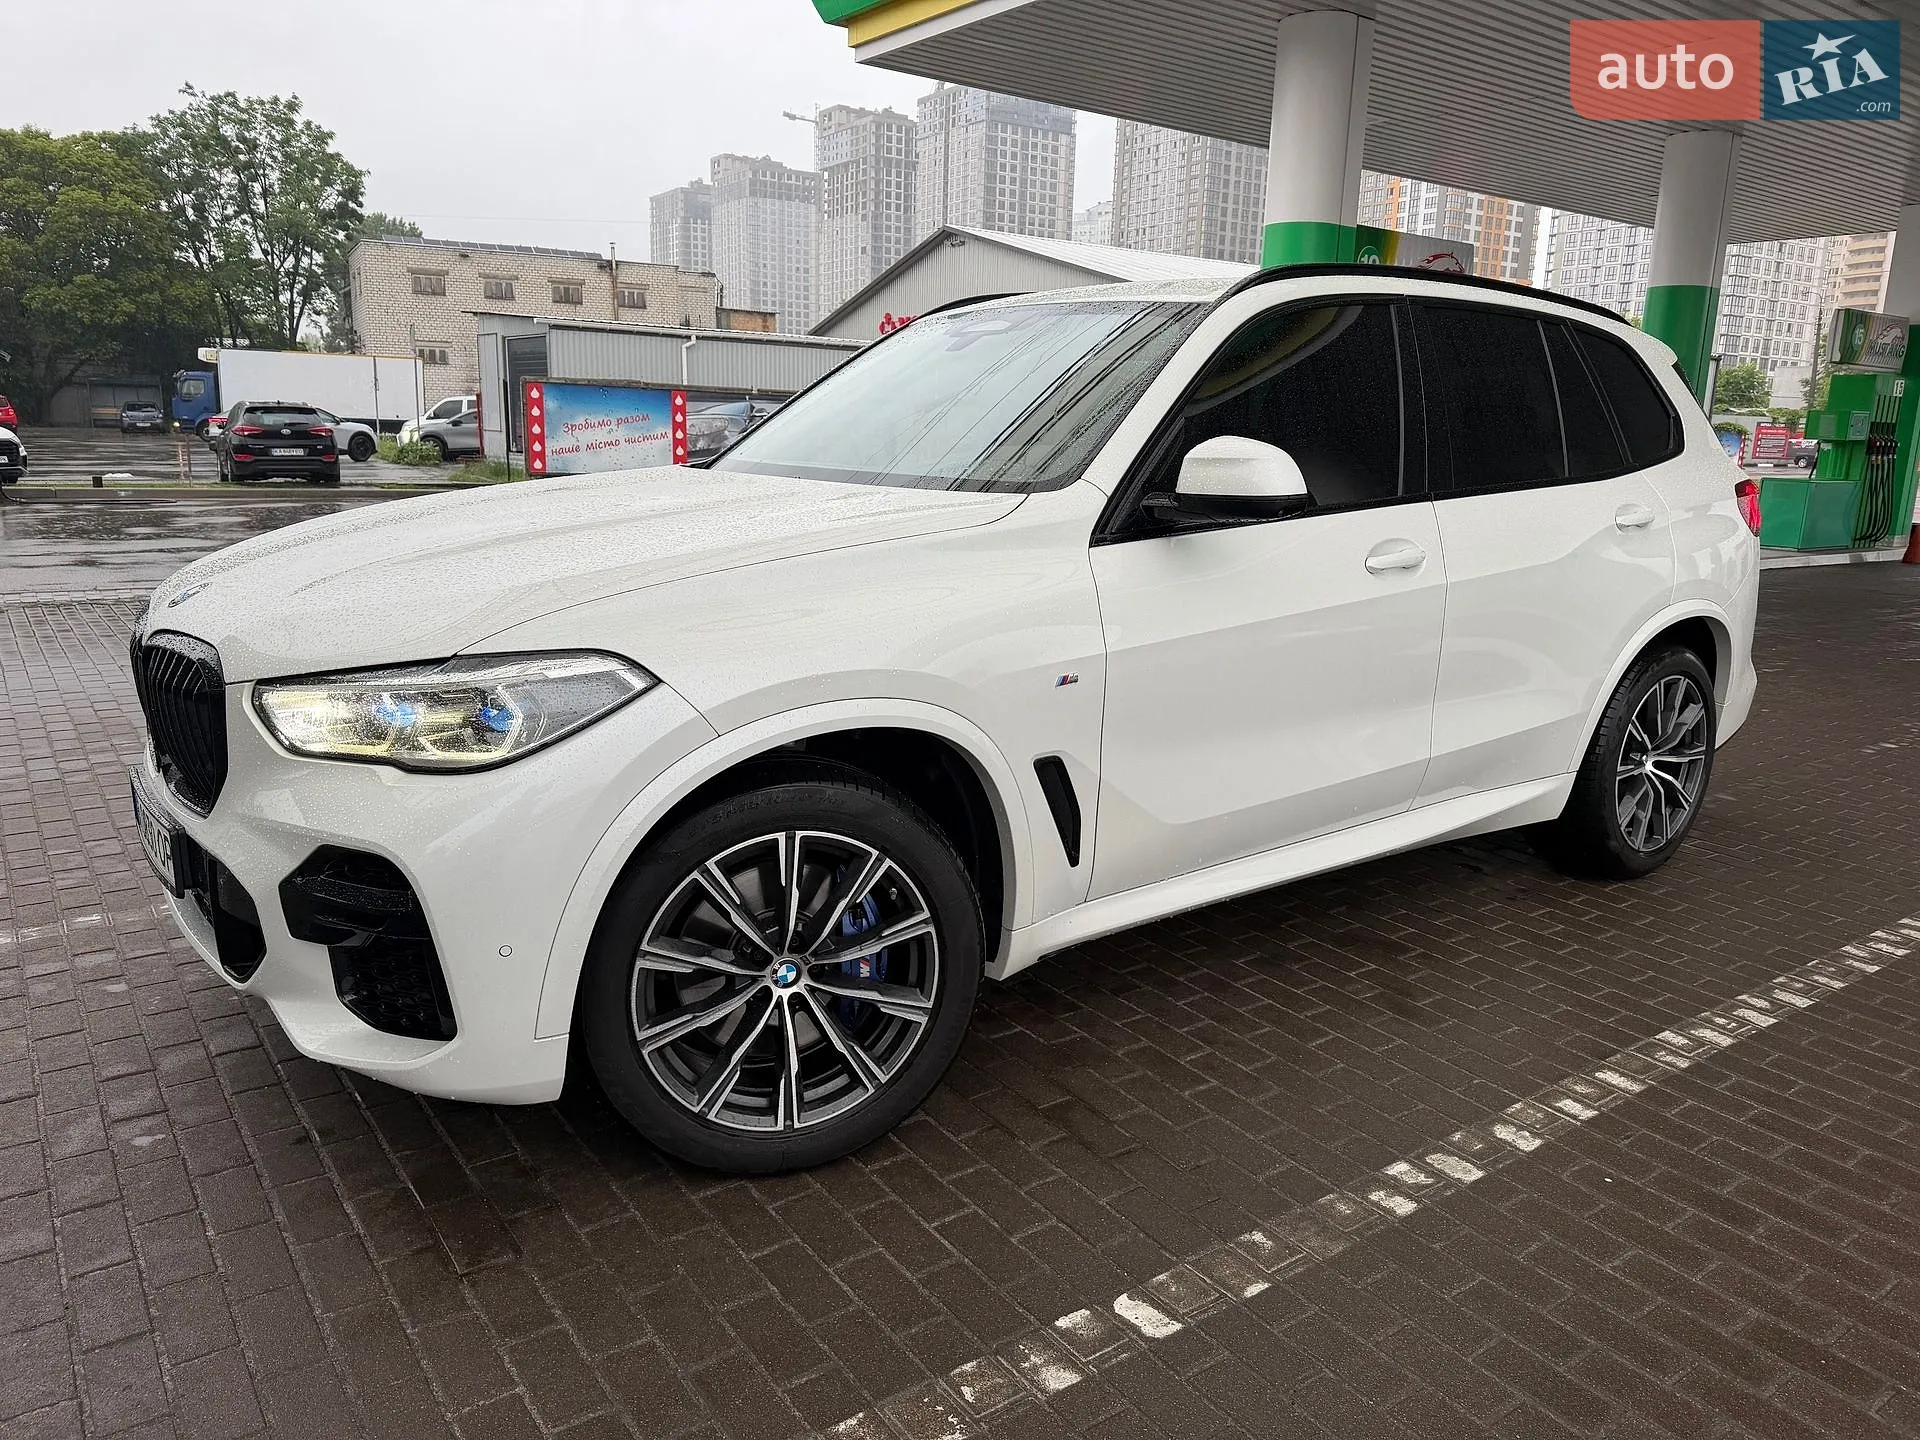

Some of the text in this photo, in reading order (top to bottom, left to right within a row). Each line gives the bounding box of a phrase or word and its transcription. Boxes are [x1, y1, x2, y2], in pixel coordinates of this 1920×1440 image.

[562, 413, 650, 437] Зробимо разом
[551, 431, 669, 456] наше місто чистим
